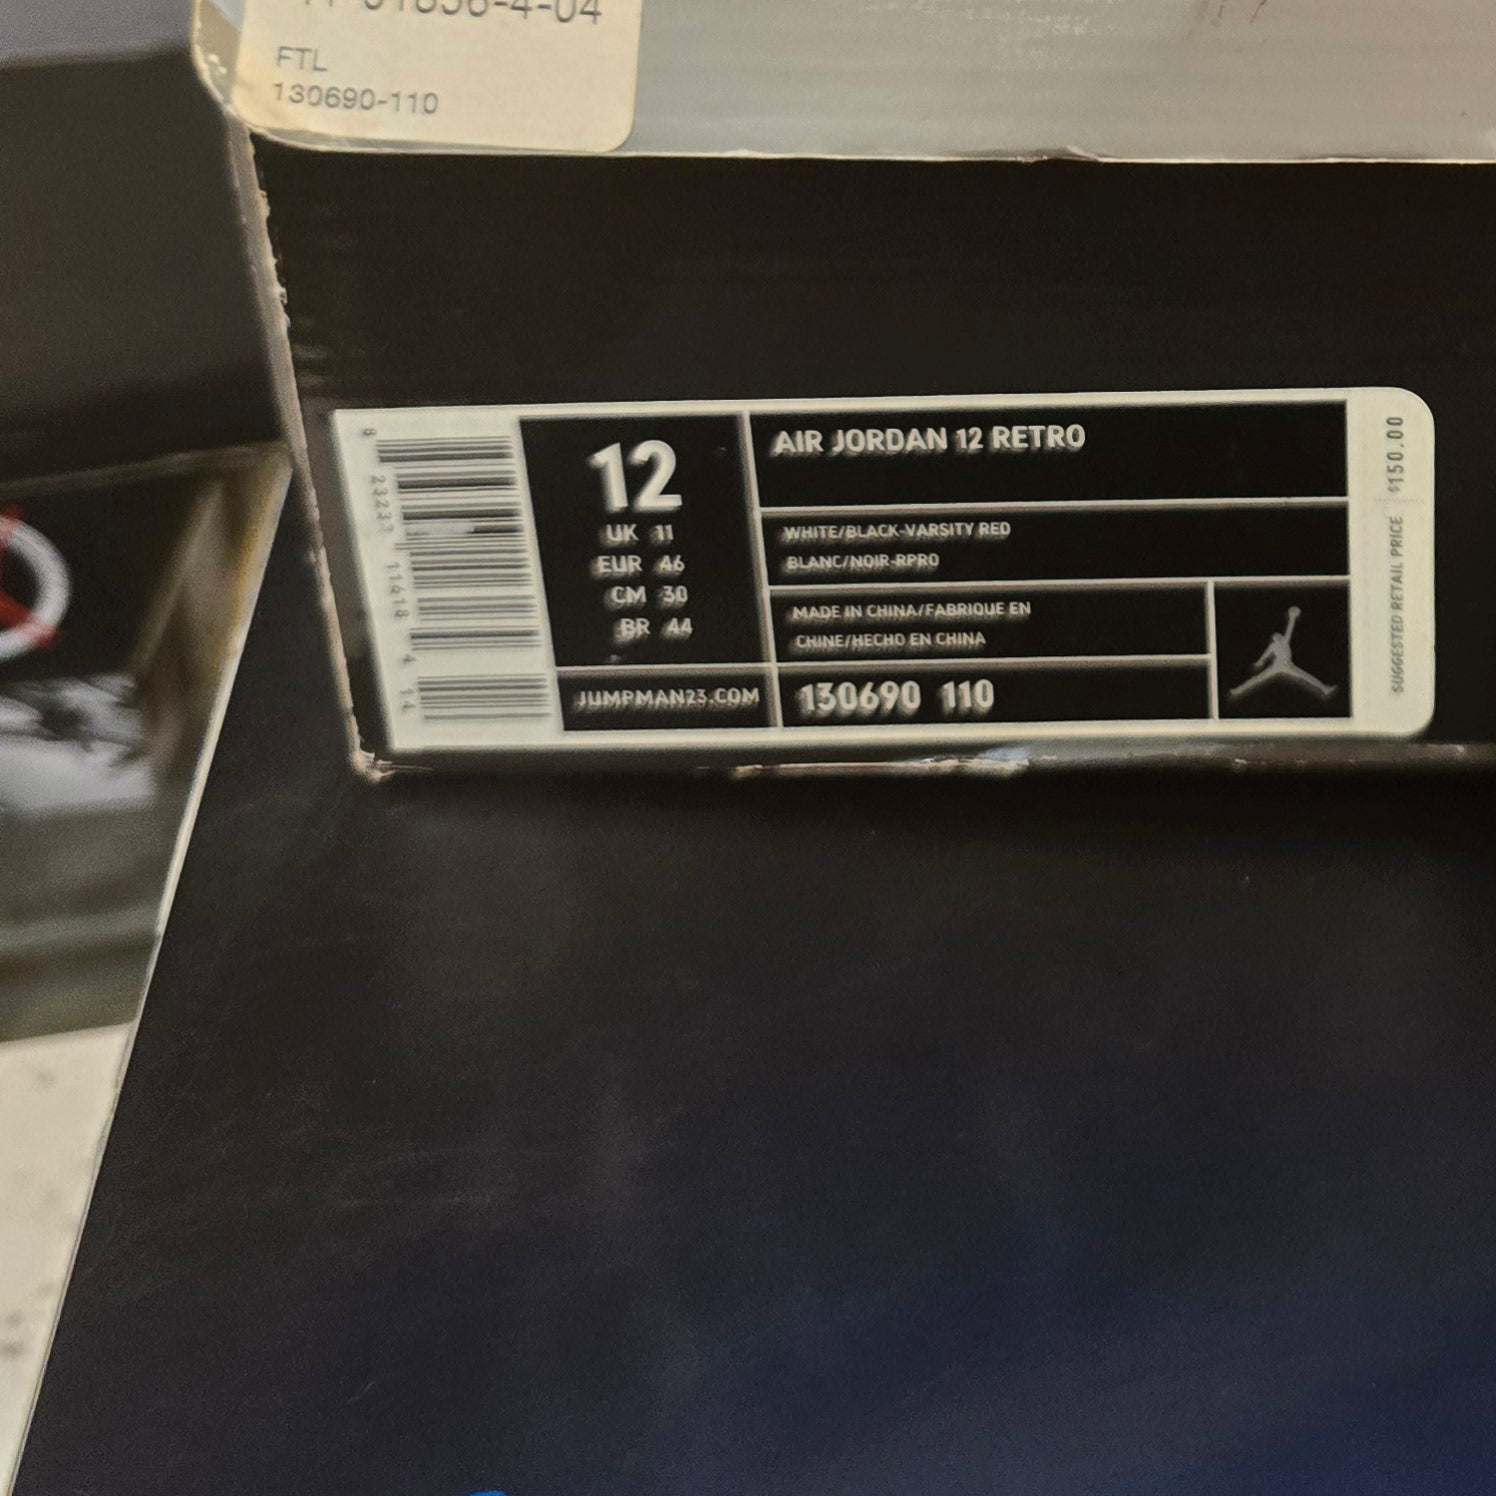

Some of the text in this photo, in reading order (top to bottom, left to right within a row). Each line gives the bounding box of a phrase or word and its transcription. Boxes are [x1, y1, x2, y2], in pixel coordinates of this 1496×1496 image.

[277, 45, 328, 72] FTL
[272, 82, 439, 115] 130690-110
[772, 424, 1086, 455] AIR JORDAN 12 RETRO
[1387, 416, 1404, 494] $150.00
[588, 439, 682, 513] 12
[604, 523, 675, 544] UK 11
[782, 521, 1011, 541] WHITE/BLACK-VARSITY RED
[594, 554, 686, 577] EUR 46
[784, 552, 940, 572] BLANC/NOIR-RPRO
[609, 584, 688, 607] CM 30
[1389, 516, 1404, 695] SUGGESTED RETAIL PRICE
[791, 600, 1031, 621] MADE IN CHINA/FABRIQUE EN
[616, 617, 693, 641] BR 44
[794, 631, 986, 650] CHINE/HECHO EN CHINA
[574, 687, 760, 708] JUMPMAN23.COM
[797, 679, 995, 712] 130690 110
